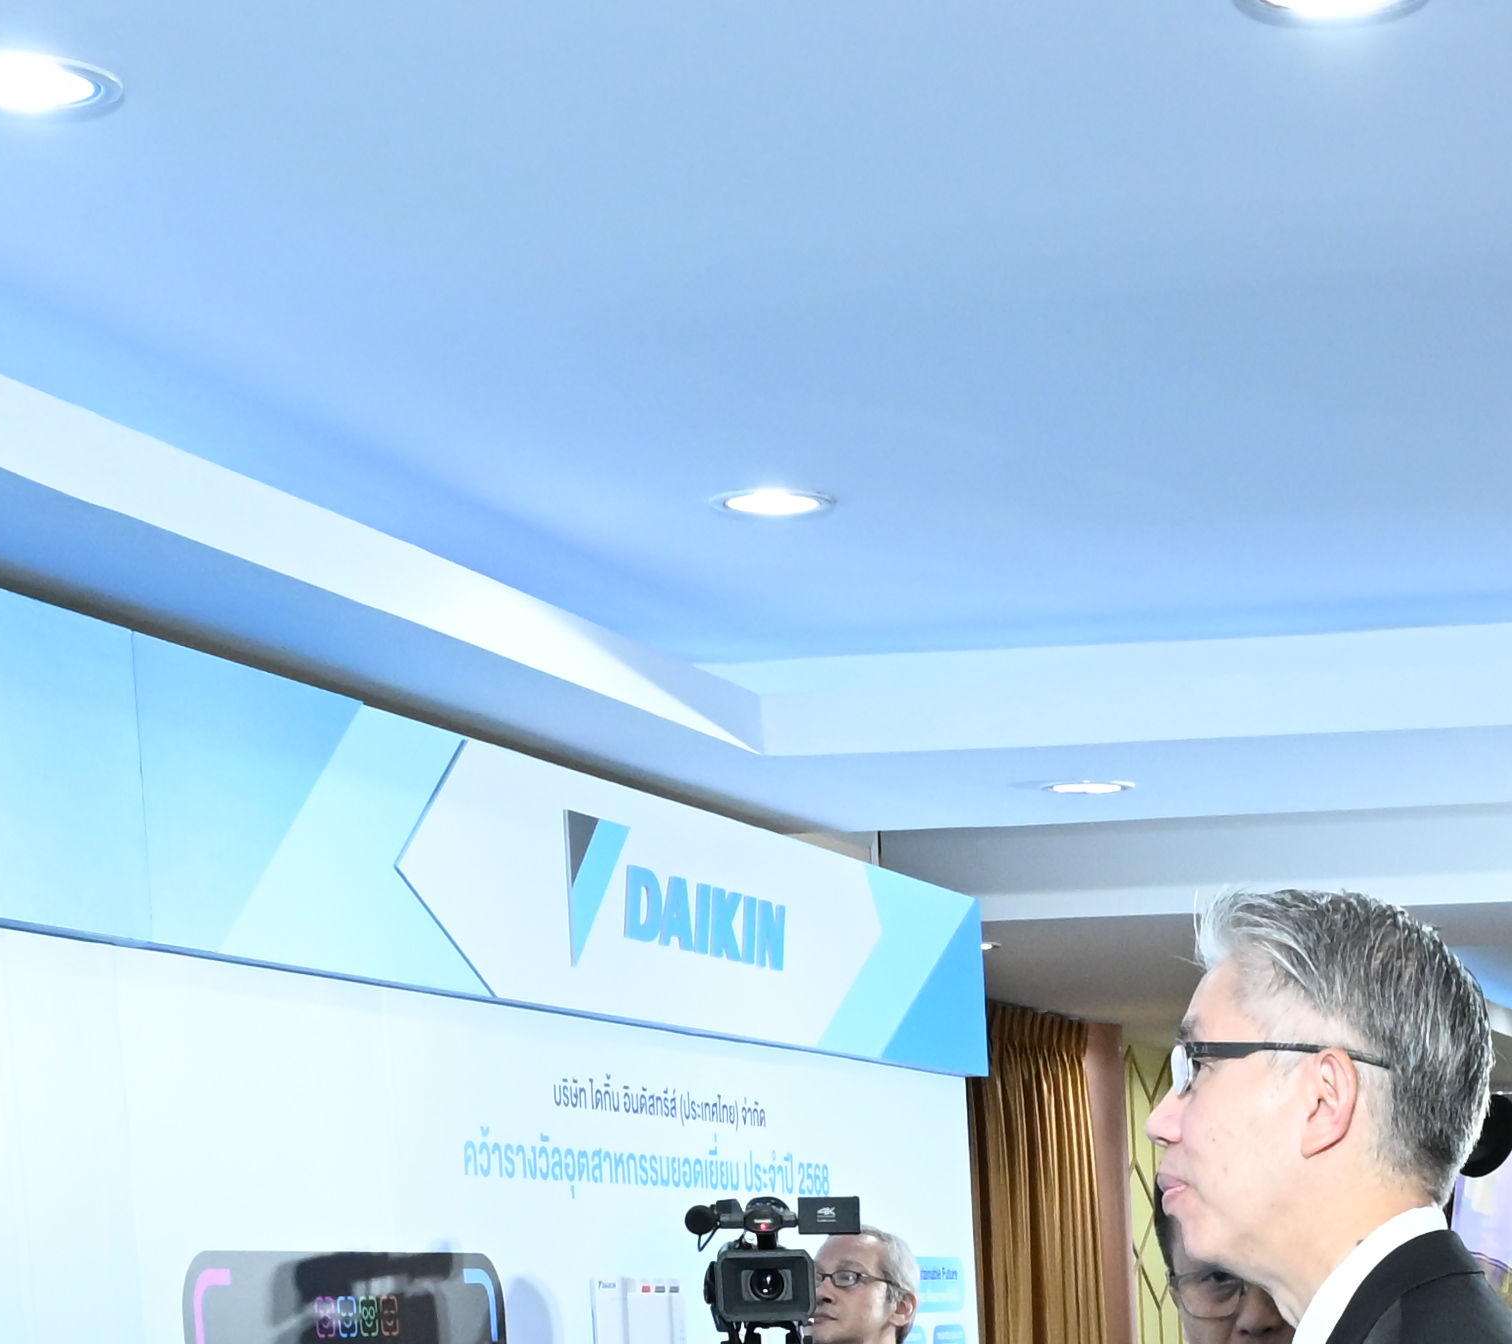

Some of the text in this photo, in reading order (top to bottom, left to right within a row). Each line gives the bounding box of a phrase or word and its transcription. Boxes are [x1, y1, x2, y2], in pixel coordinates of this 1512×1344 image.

[624, 865, 785, 971] DAIKIN
[553, 1078, 587, 1109] บริษัท
[680, 1091, 738, 1132] (ประเทศไทย)
[741, 1097, 766, 1128] จำกัด
[744, 1150, 794, 1195] ประจำปี
[798, 1162, 830, 1196] 2568
